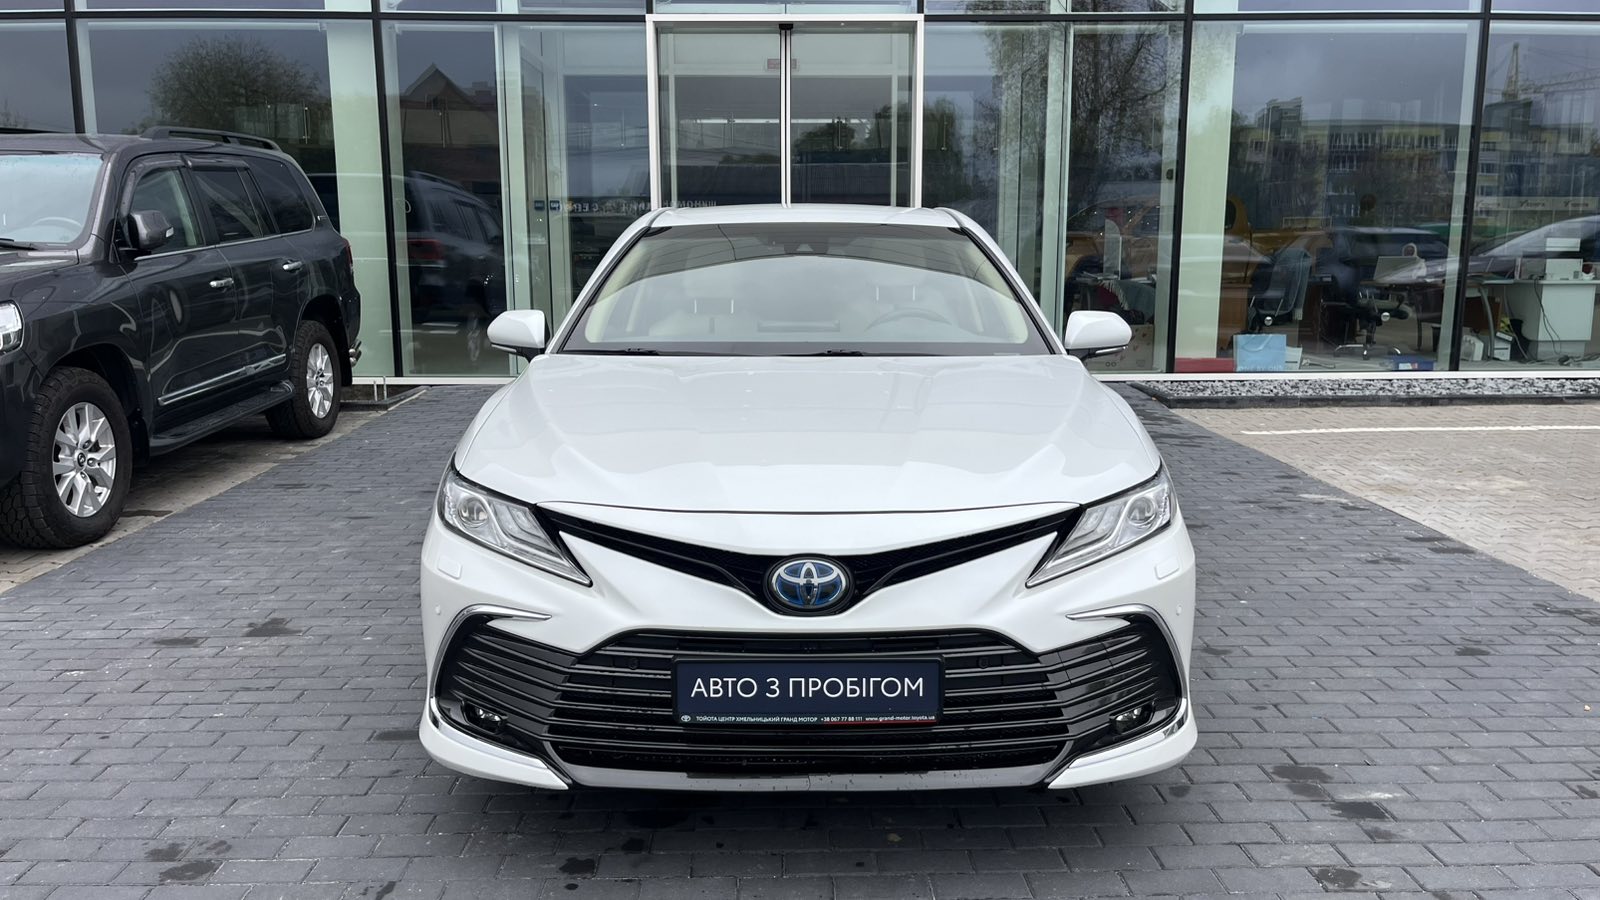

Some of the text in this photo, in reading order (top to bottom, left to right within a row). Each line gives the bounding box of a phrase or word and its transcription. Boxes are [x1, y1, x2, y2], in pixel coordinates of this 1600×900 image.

[690, 677, 758, 698] АВТО
[789, 677, 924, 698] ПРОБІГОМ
[736, 715, 780, 723] ХМЕЛЬНИЦЬКИЙ
[865, 715, 936, 723] www.grand-motor.toyota.ua
